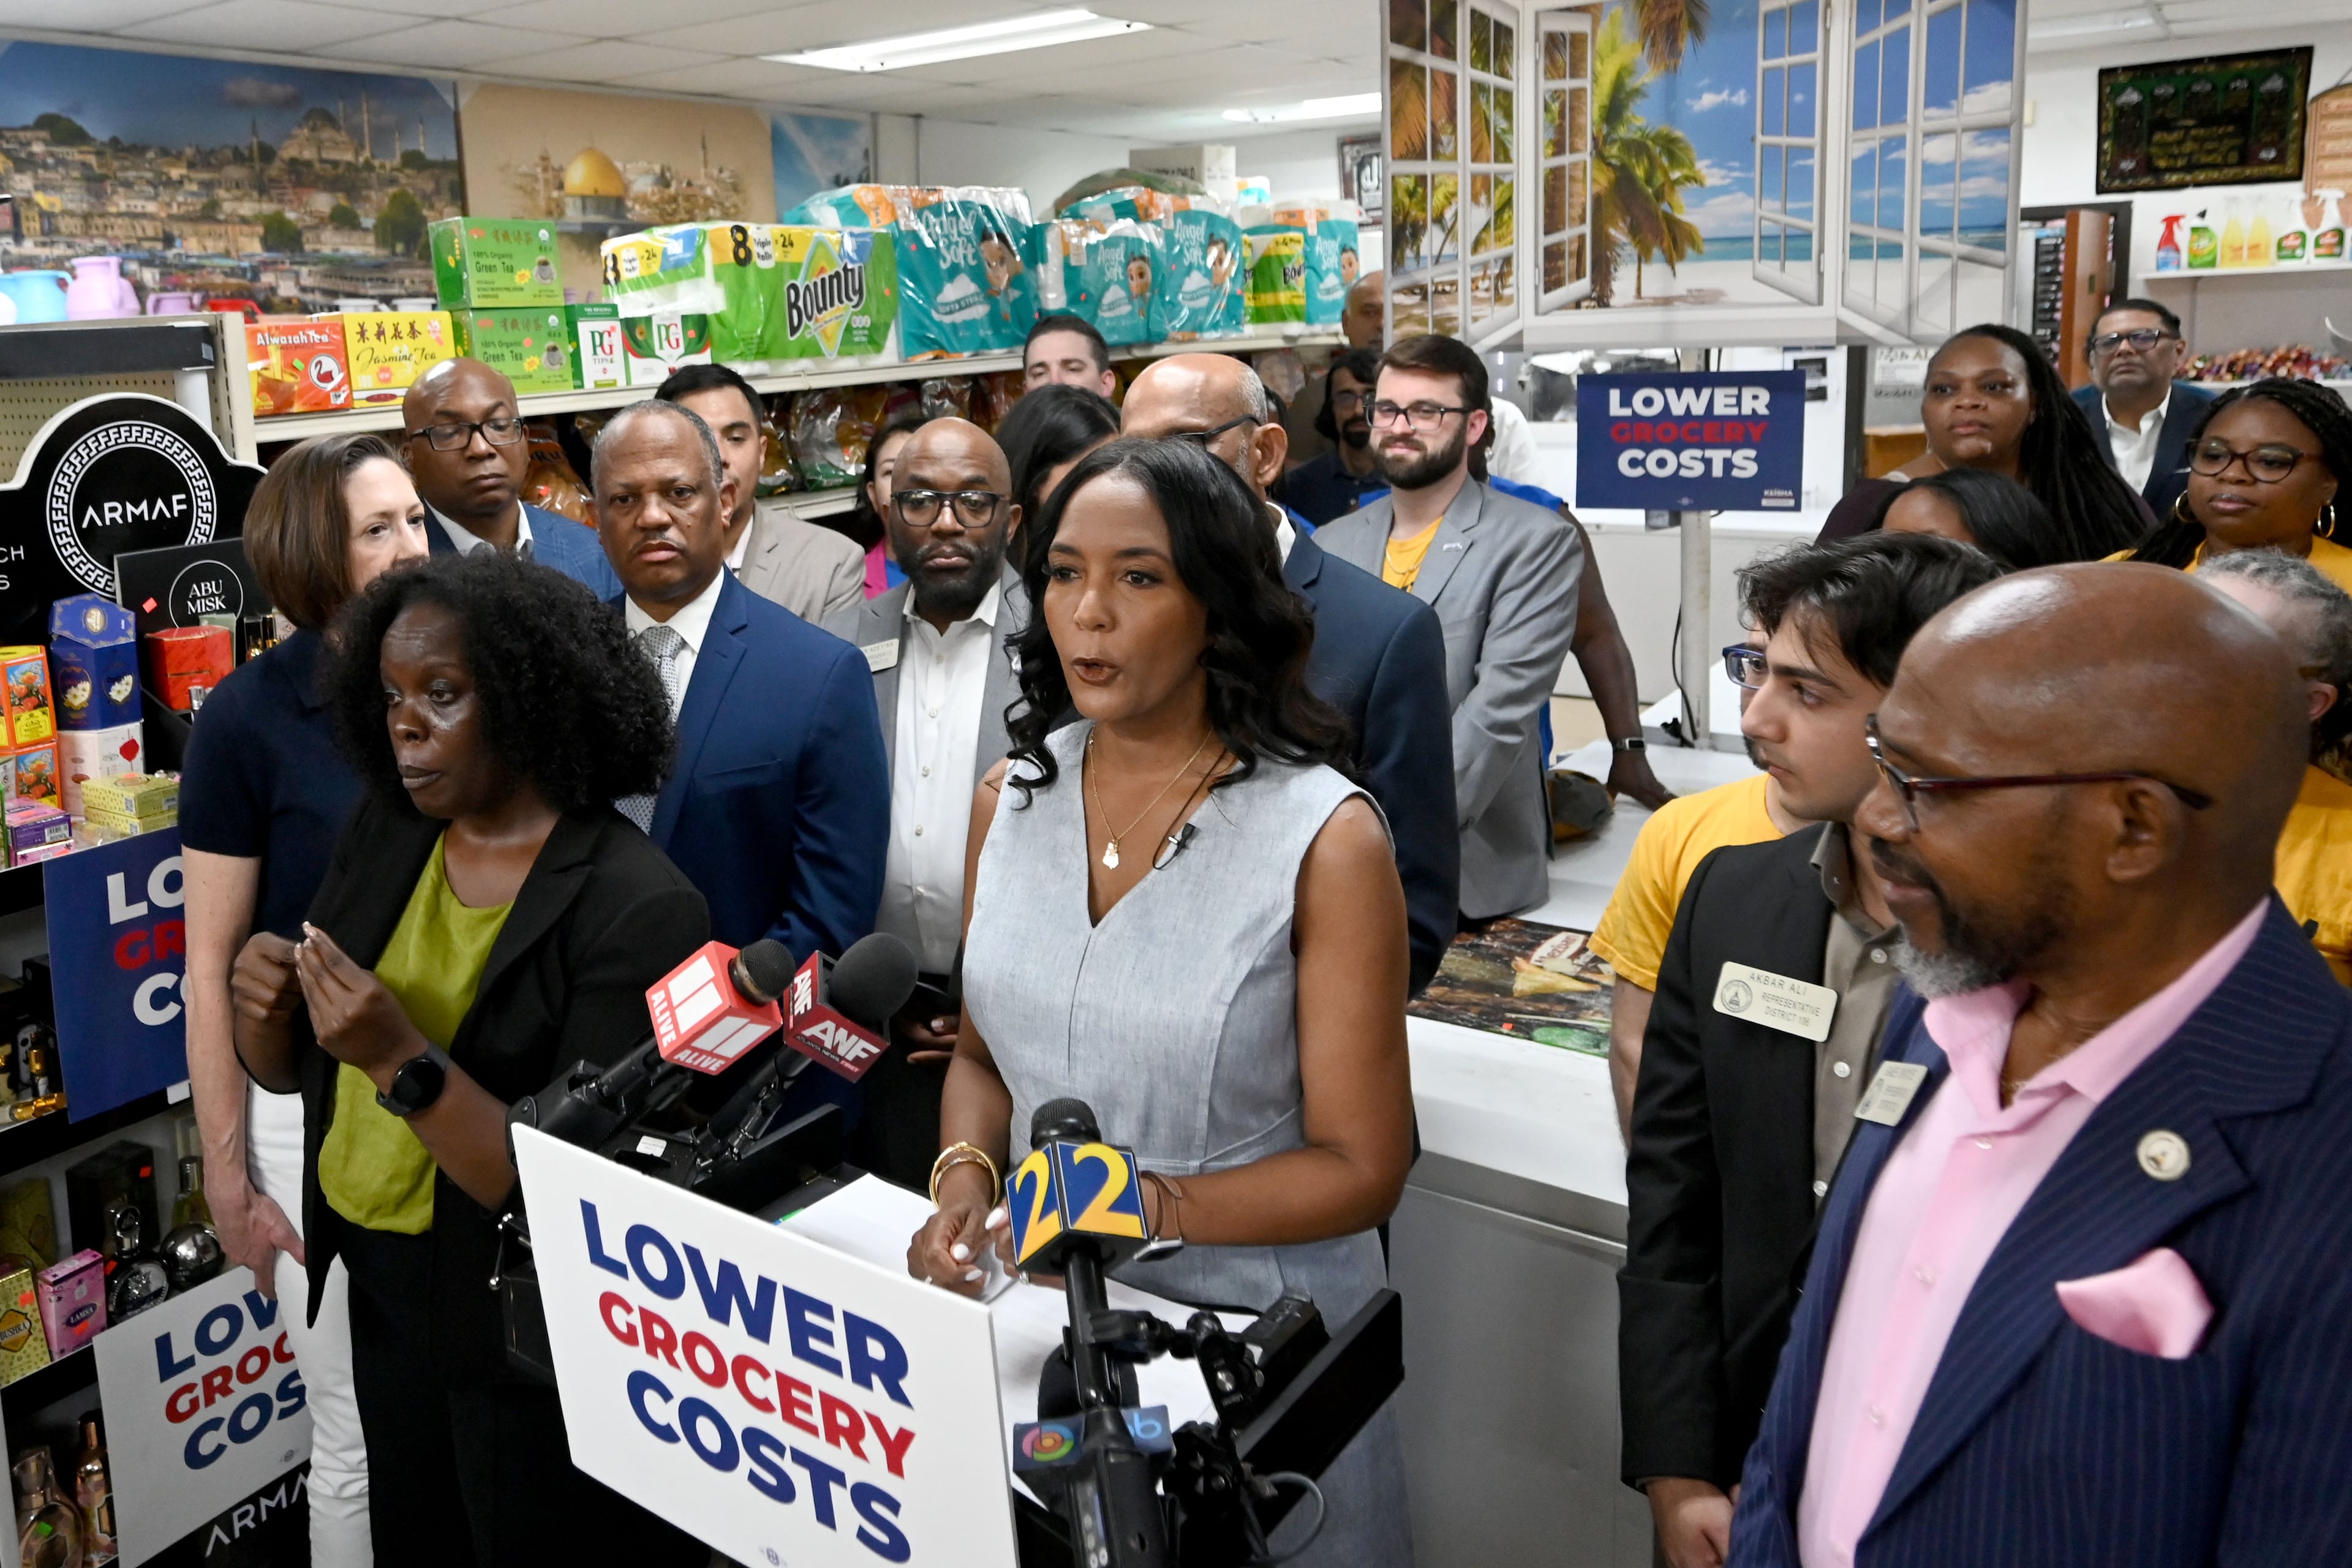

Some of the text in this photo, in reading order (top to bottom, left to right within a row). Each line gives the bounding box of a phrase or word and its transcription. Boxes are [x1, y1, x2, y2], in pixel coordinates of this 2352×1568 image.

[922, 210, 976, 243] Angel
[1174, 218, 1207, 245] Angel
[730, 225, 753, 267] 8
[753, 238, 771, 249] Triple
[780, 233, 794, 248] 24
[940, 237, 977, 269] Soft
[1183, 241, 1205, 266] Soft
[1317, 236, 1341, 255] Angel
[645, 249, 657, 260] 24
[1098, 243, 1126, 265] Angel
[1322, 253, 1338, 271] Soft
[475, 262, 514, 273] Green Tea
[603, 254, 620, 285] 8
[1105, 262, 1124, 282] Soft
[786, 262, 864, 337] Bounty
[310, 330, 329, 344] Tea
[589, 330, 614, 356] PG
[657, 323, 680, 350] PG
[356, 347, 436, 370] Jasmine Tea
[483, 350, 523, 363] Green Tea
[1609, 386, 1771, 417] LOWER
[1610, 421, 1769, 444] GROCERY
[1618, 448, 1758, 478] COSTS
[82, 494, 187, 528] ARMAF
[189, 579, 222, 598] ABU
[187, 595, 227, 614] MISK
[794, 968, 812, 1016] ANF
[1749, 973, 1807, 996] AKBAR ALI
[1762, 992, 1821, 1017] REPRESENTATIVE
[1765, 1006, 1796, 1022] DISTRICT
[651, 990, 676, 1048] ALIVE
[796, 1035, 860, 1072] ATLANTA NEWS FIRST
[801, 1020, 881, 1061] ANF
[673, 1049, 726, 1071] ALIVE
[1068, 1143, 1147, 1238] 2
[1016, 1151, 1061, 1263] 2
[579, 1198, 915, 1411] LOWER
[599, 1291, 916, 1479] GROCERY
[627, 1370, 911, 1563] COSTS
